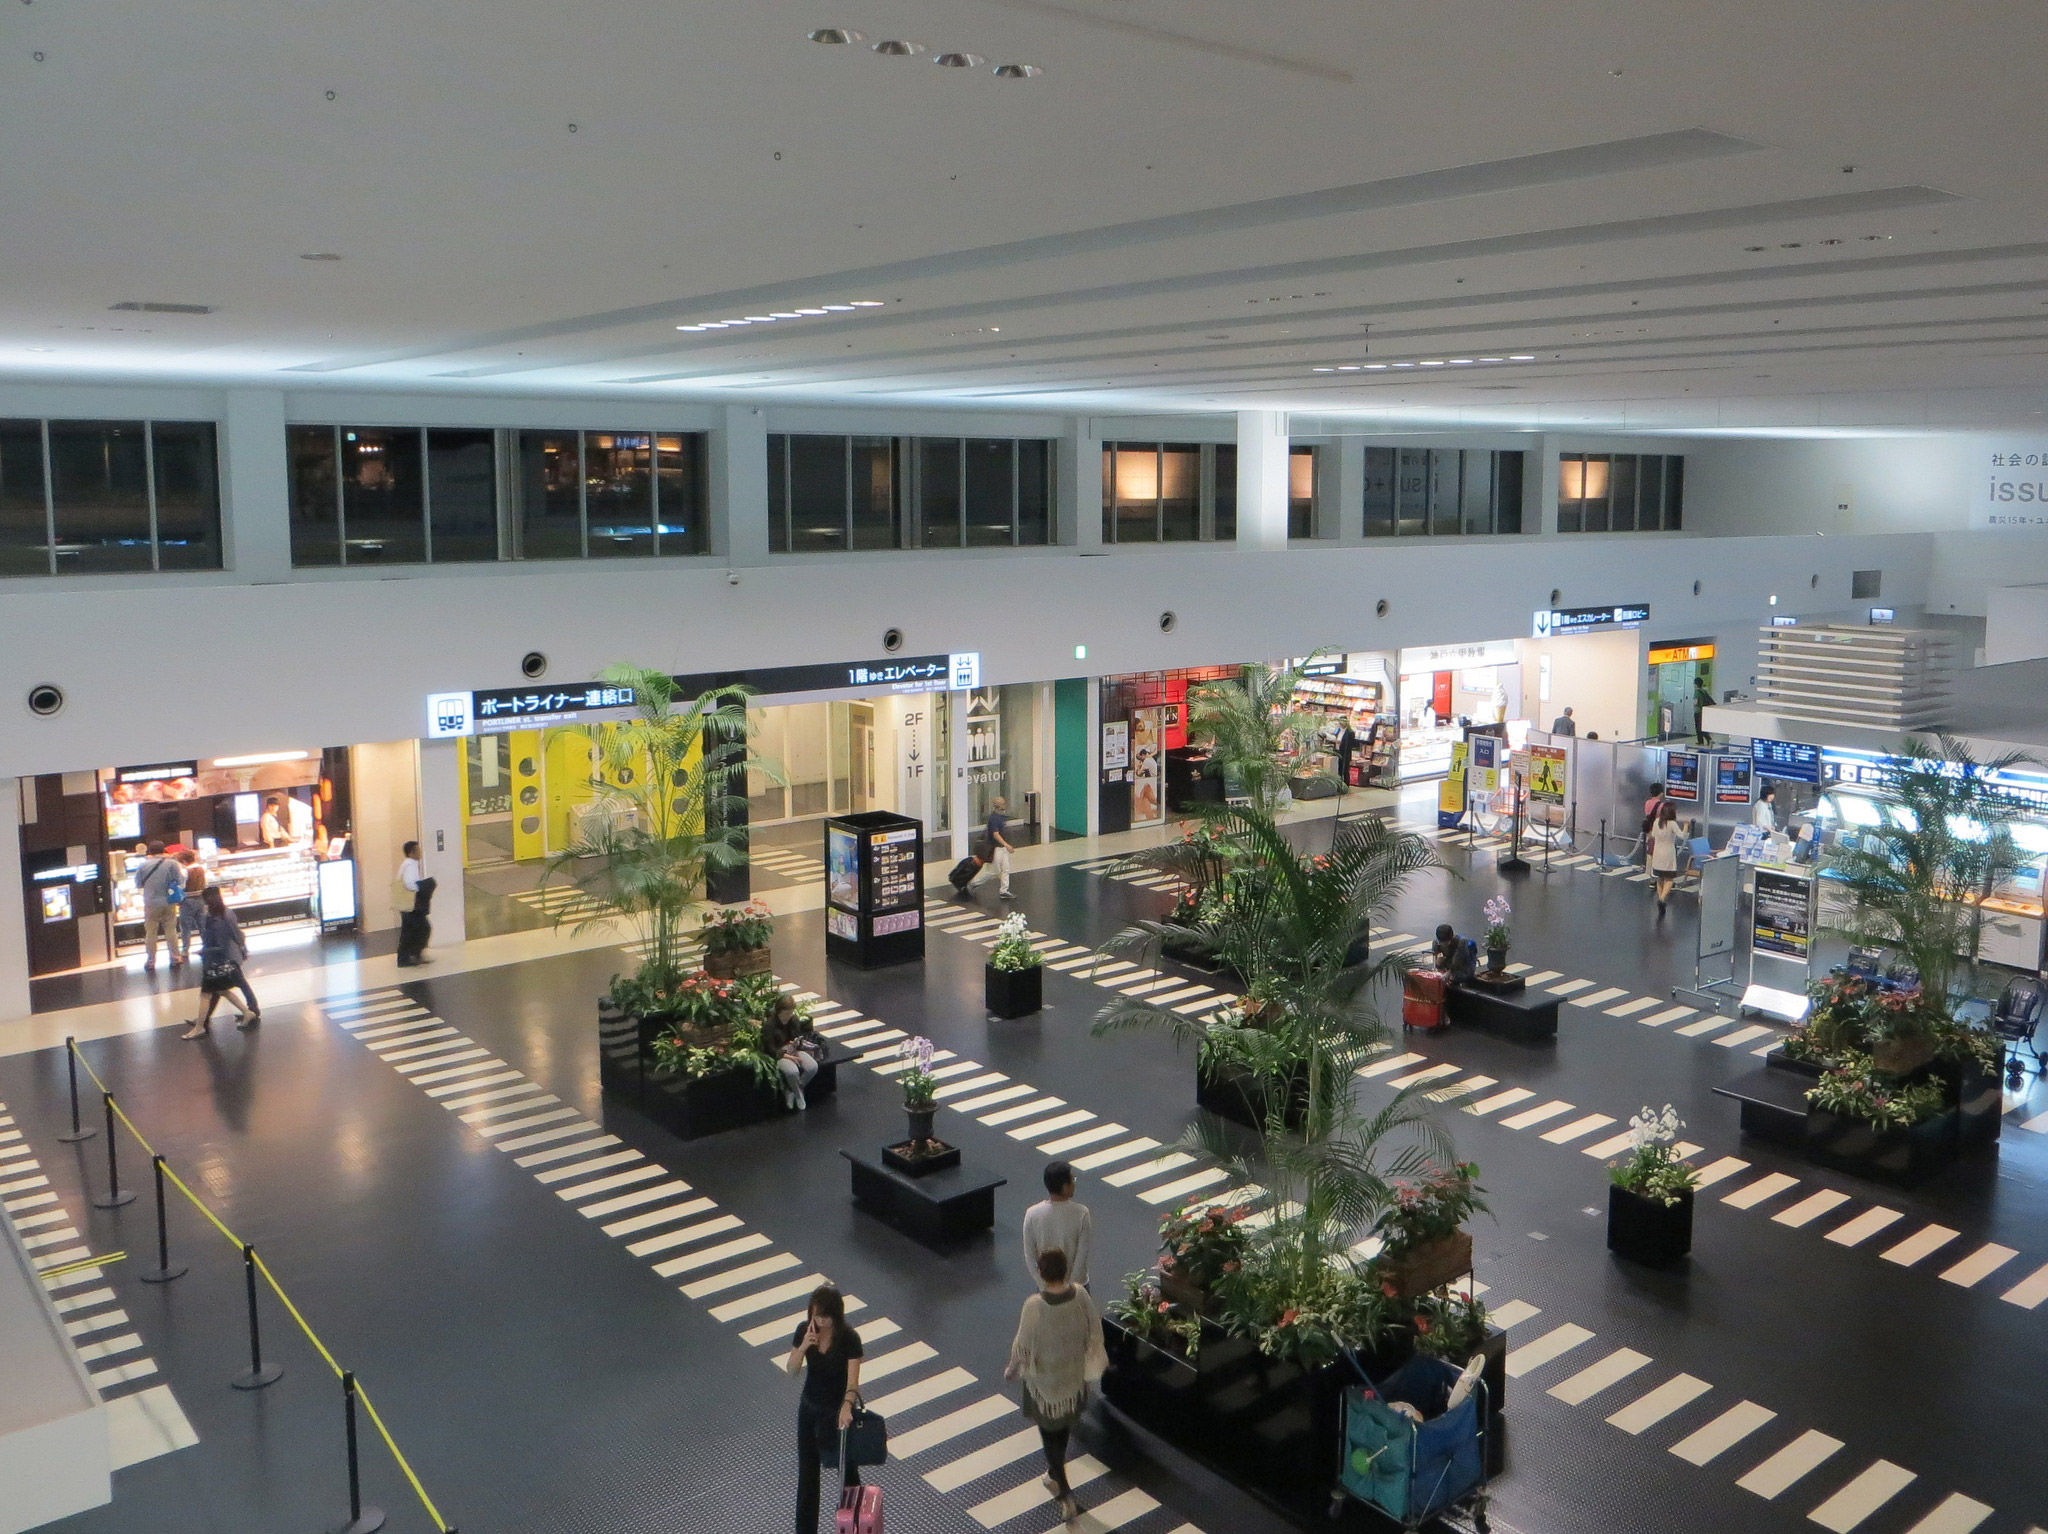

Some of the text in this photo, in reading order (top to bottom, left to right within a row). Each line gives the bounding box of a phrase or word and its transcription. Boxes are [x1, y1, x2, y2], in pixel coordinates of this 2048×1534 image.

[1672, 647, 1689, 660] ATM
[848, 663, 947, 684] 1階ゆきエレベーター
[481, 688, 634, 715] ポートライナー連絡口
[482, 717, 522, 727] PORTLINER
[534, 714, 562, 722] transfer
[905, 712, 923, 726] 2F
[907, 765, 924, 778] 1F
[1824, 764, 1834, 779] 5
